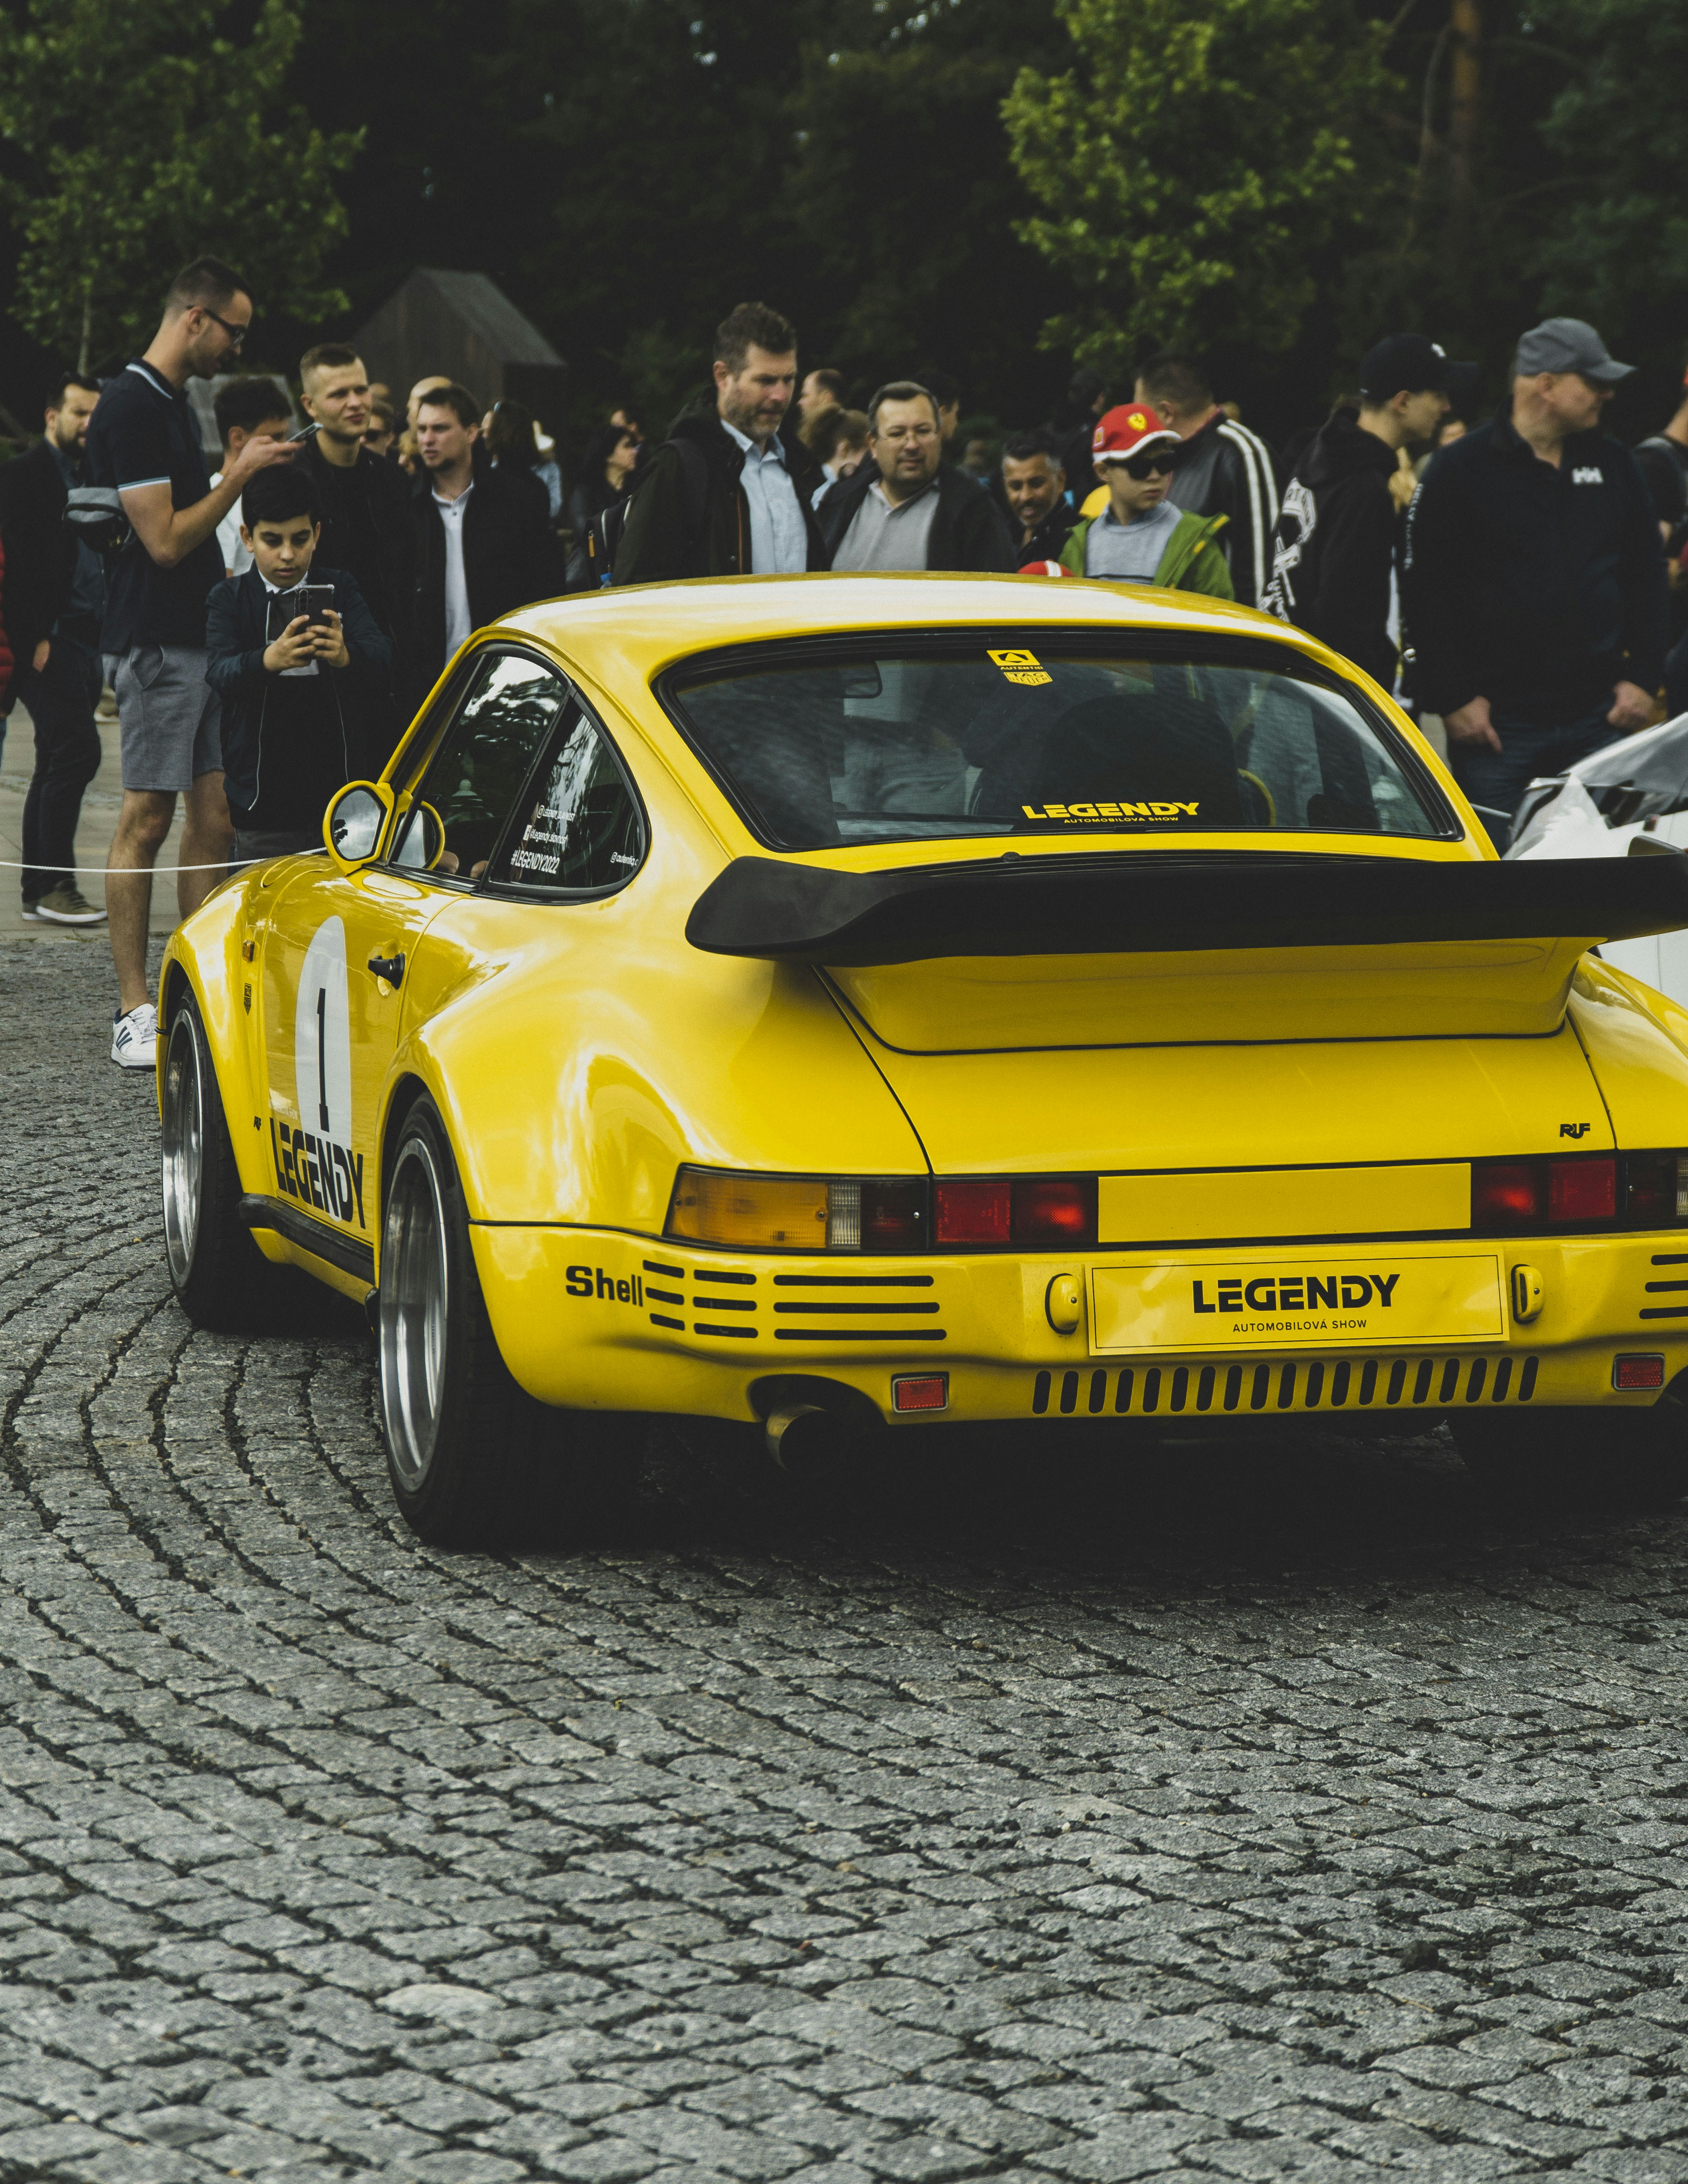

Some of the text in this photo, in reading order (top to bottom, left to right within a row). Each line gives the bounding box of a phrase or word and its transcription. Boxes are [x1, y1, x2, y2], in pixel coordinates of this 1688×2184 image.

[1022, 802, 1200, 819] LEGENDY
[510, 850, 561, 874] #LEGENDY2022
[317, 987, 330, 1133] 1
[1560, 1123, 1591, 1139] RUF
[269, 1116, 366, 1230] LEGENDY
[566, 1265, 643, 1307] Shell
[1193, 1274, 1400, 1313] LEGENDY
[1233, 1319, 1367, 1332] AUTOMOBILOVÁ SHOW
